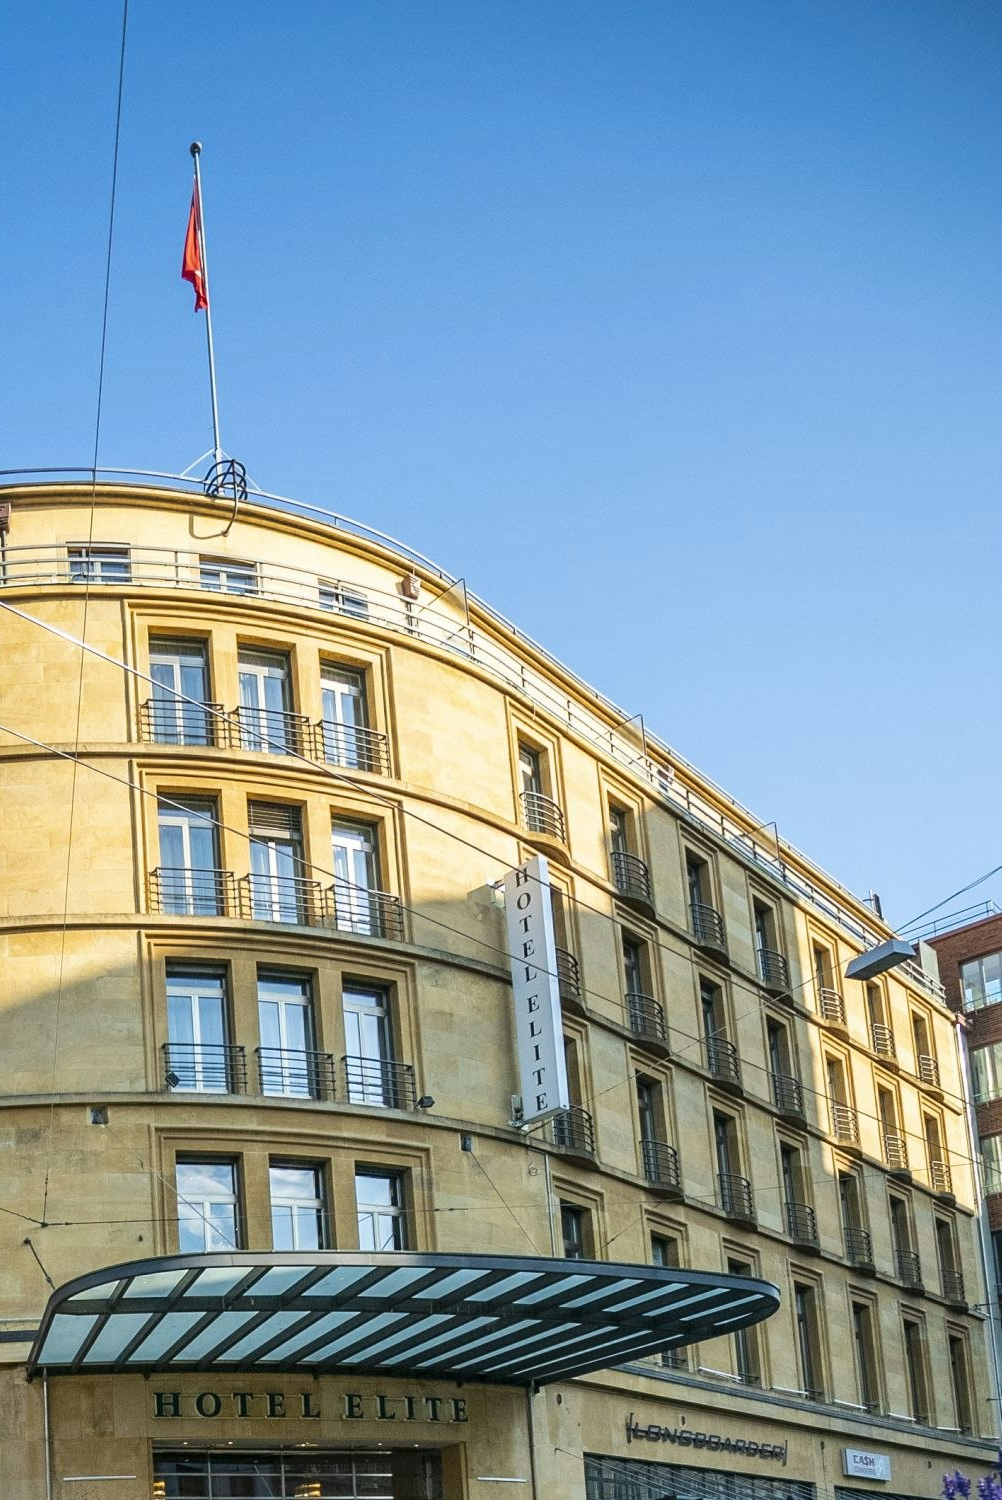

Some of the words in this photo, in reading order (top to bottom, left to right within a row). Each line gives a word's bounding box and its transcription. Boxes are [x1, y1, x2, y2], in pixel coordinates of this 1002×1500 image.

[514, 866, 538, 984] HOTEL
[527, 993, 549, 1112] ELITE
[153, 1391, 321, 1419] HOTEL
[342, 1393, 469, 1423] ELITE
